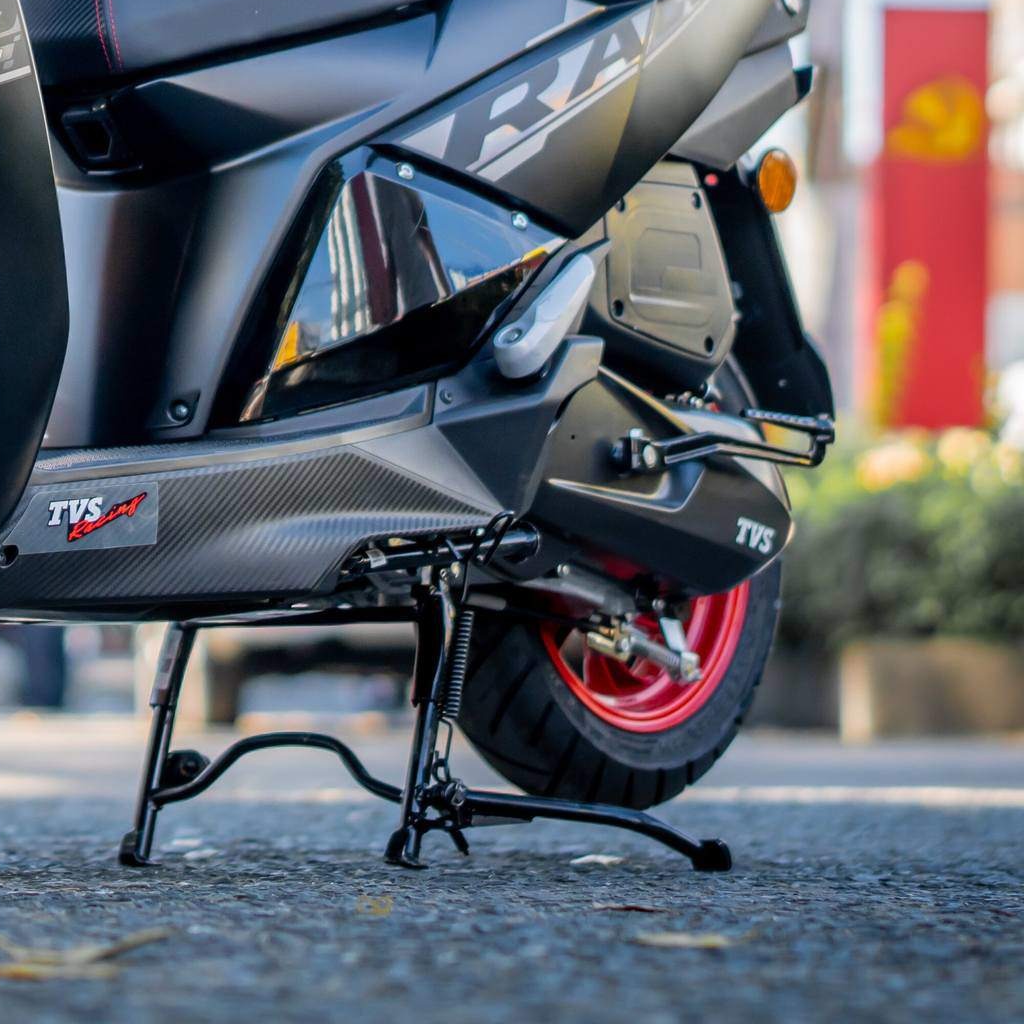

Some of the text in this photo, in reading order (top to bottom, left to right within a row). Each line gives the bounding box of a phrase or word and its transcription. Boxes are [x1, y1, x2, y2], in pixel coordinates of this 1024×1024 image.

[48, 497, 103, 526] TVS
[68, 492, 147, 542] Racing
[735, 516, 776, 555] TVS
